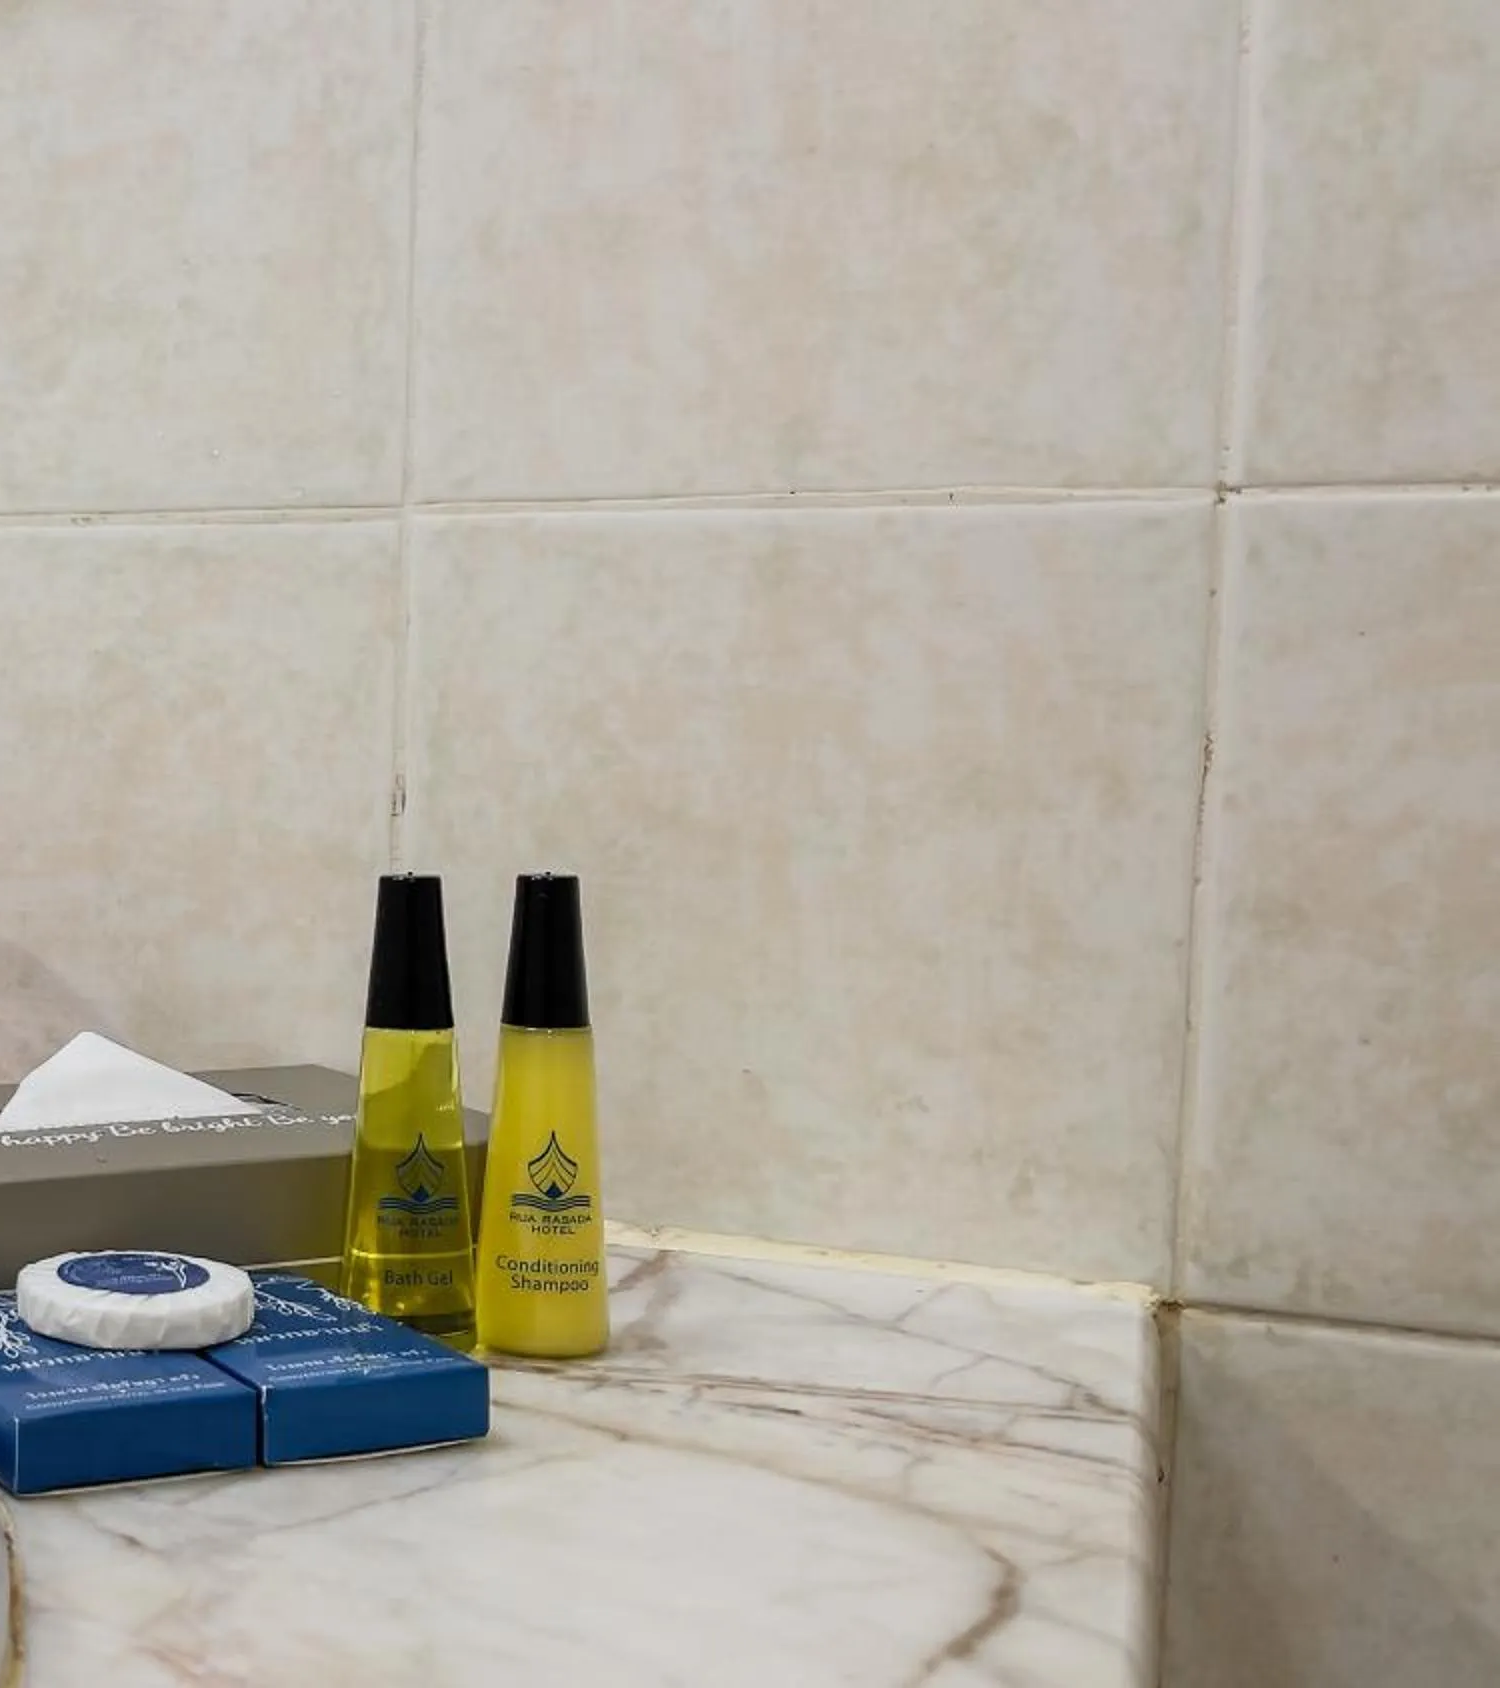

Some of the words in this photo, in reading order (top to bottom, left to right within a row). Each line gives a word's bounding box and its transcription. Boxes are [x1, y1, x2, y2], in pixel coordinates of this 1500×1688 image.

[1, 1130, 101, 1146] happy
[108, 1123, 157, 1137] Be
[161, 1116, 263, 1134] bright
[267, 1113, 315, 1125] Be
[321, 1114, 358, 1125] yo
[531, 1225, 576, 1235] HOTEL
[495, 1256, 599, 1276] Conditioning
[385, 1269, 422, 1286] Bath
[428, 1269, 453, 1286] Gel
[510, 1275, 588, 1294] Shampoo
